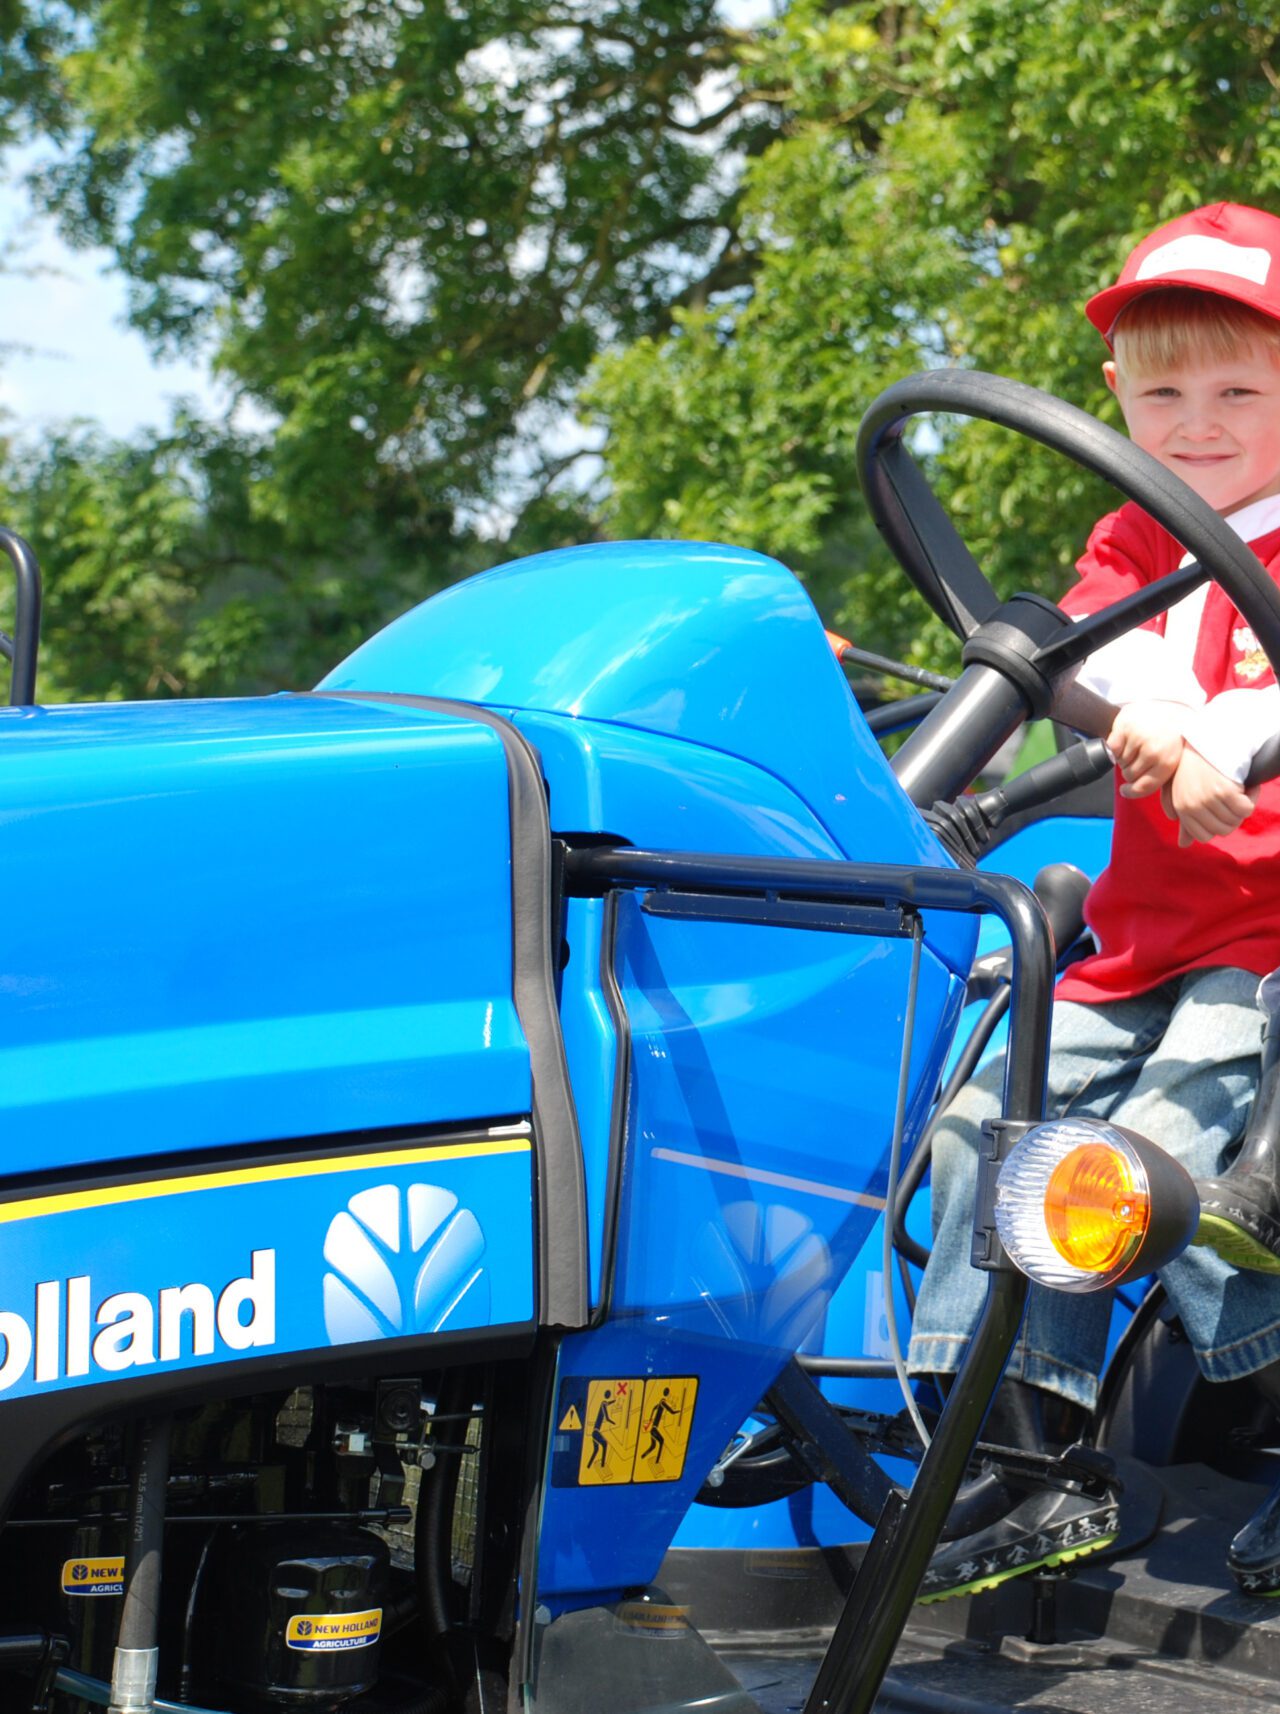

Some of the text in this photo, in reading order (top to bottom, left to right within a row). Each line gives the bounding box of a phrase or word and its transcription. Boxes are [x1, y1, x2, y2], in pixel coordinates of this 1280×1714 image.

[136, 1495, 143, 1513] mm
[91, 1567, 119, 1578] NEW
[315, 1617, 379, 1634] NEW HOLLAND
[312, 1636, 367, 1648] AGRICULTURE
